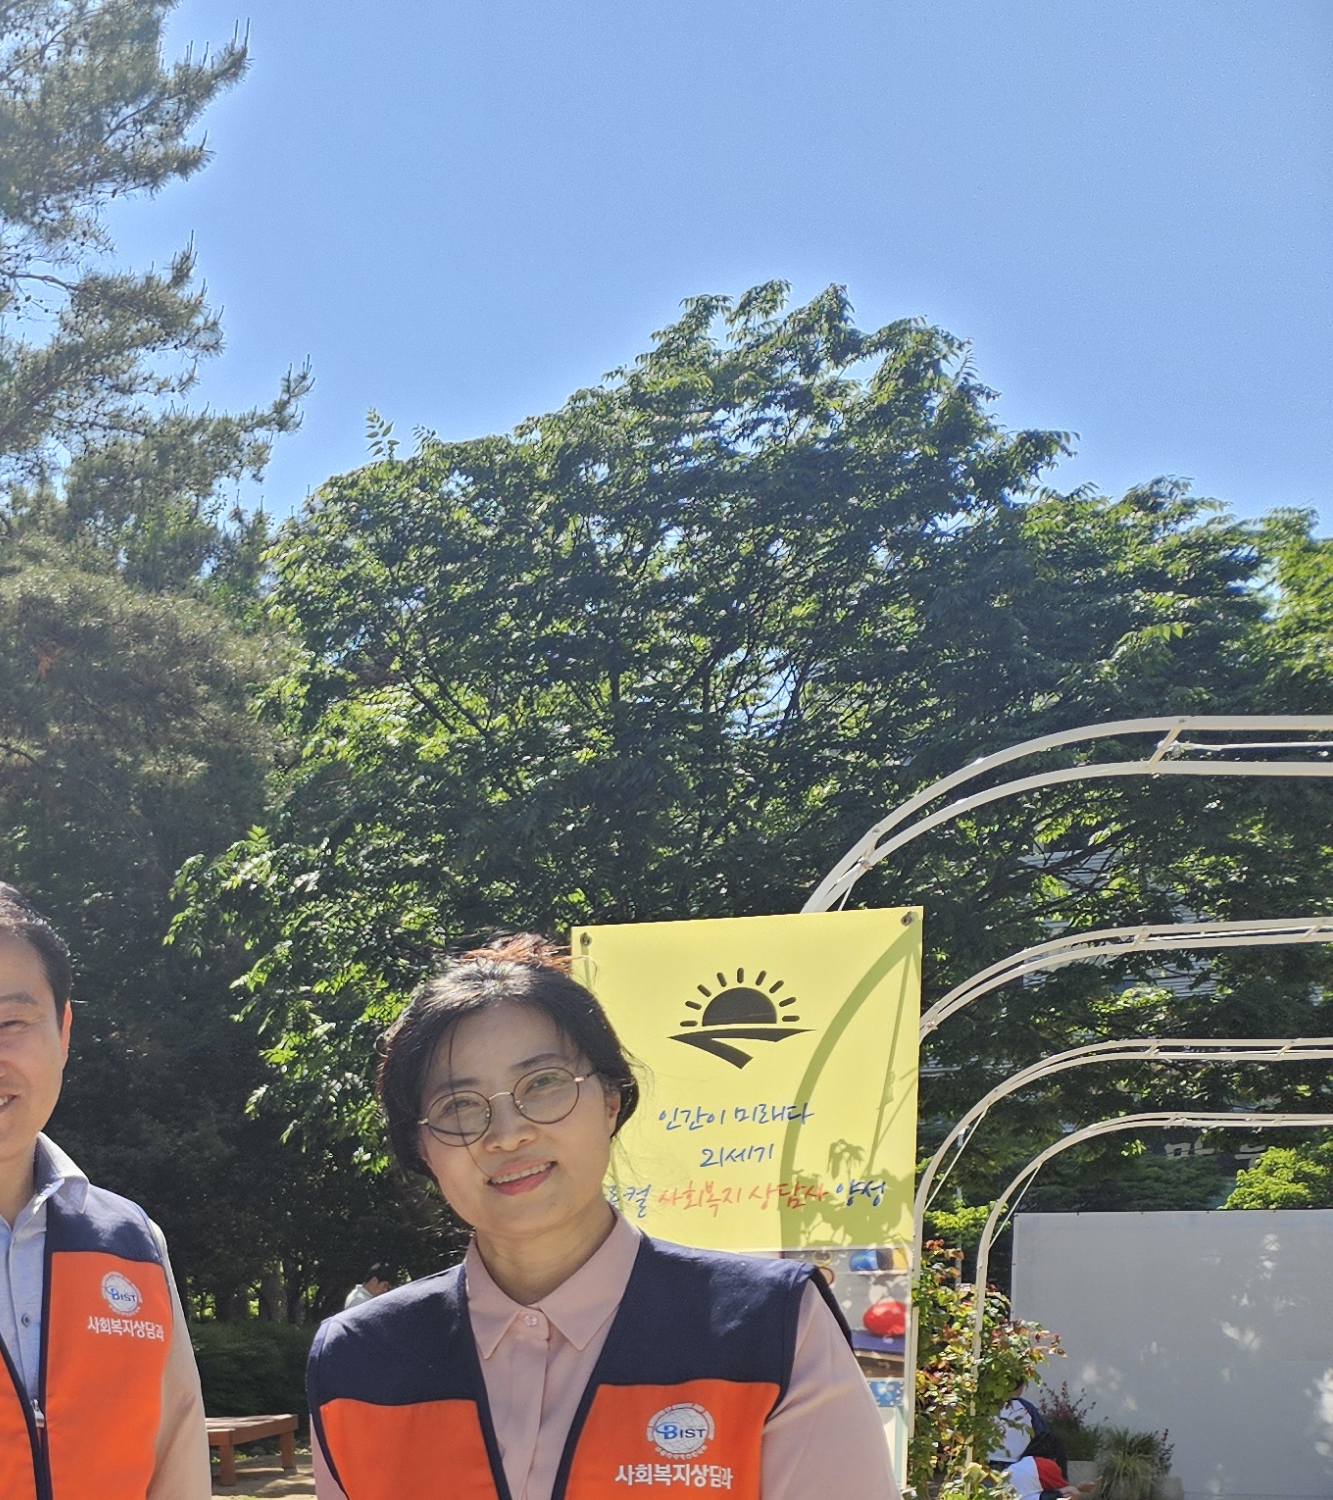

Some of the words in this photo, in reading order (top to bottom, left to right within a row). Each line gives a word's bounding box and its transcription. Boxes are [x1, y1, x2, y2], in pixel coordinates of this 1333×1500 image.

[659, 1106, 725, 1131] 인간이
[734, 1102, 815, 1127] 미래다
[699, 1144, 774, 1169] 21세기
[658, 1180, 742, 1217] 사회복지
[748, 1182, 829, 1210] 상담사
[835, 1181, 886, 1208] 양성
[105, 1285, 136, 1302] BIST
[88, 1316, 164, 1341] 사회복지상담과
[655, 1421, 706, 1440] BIST
[615, 1463, 733, 1490] 사회복지상담과
